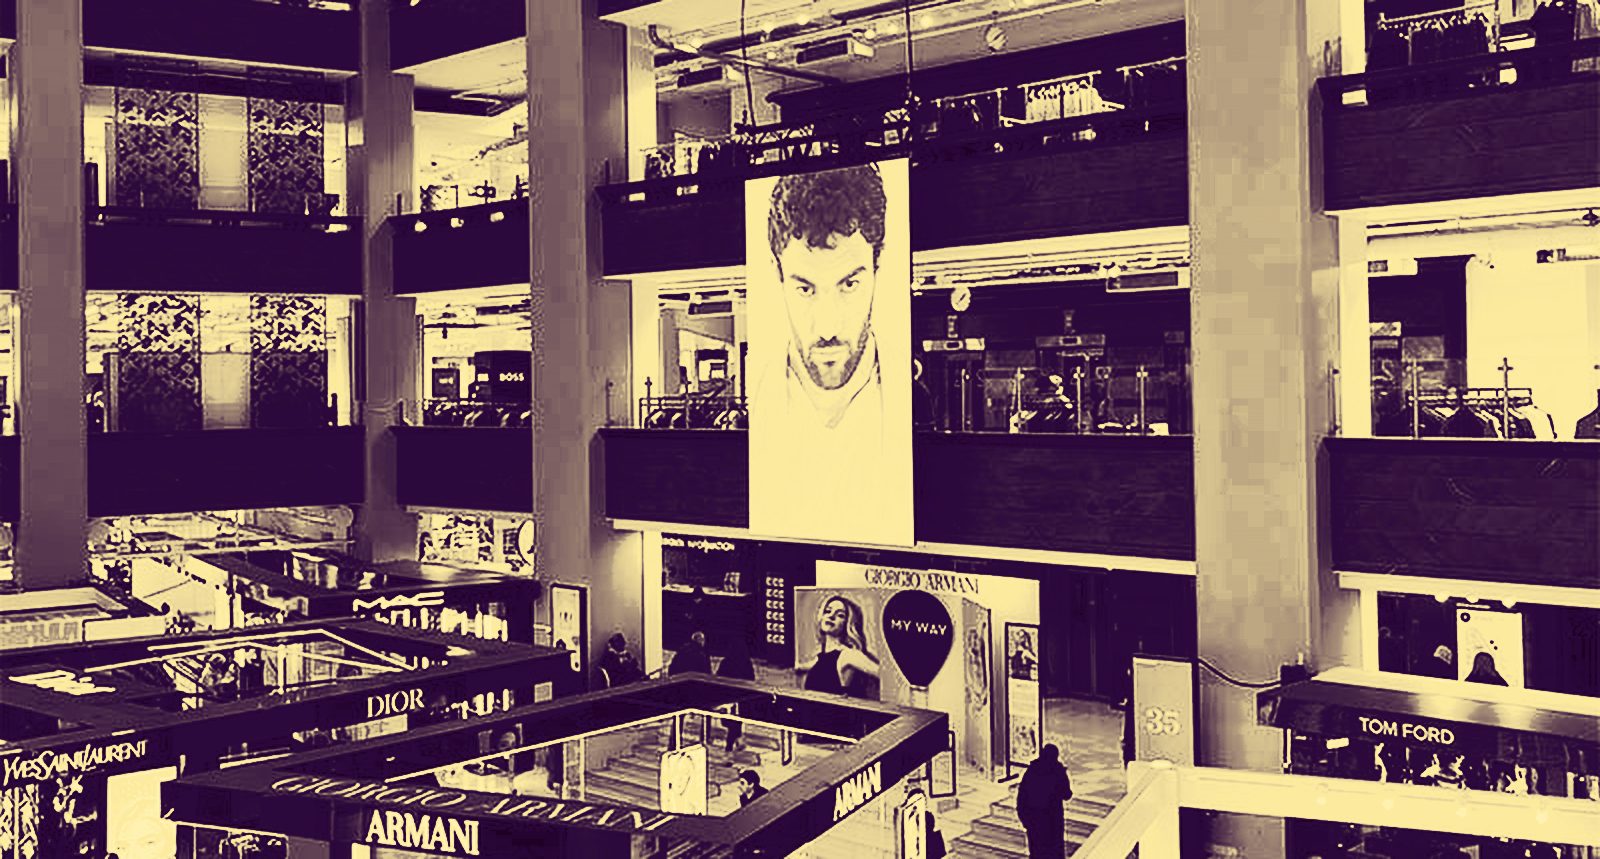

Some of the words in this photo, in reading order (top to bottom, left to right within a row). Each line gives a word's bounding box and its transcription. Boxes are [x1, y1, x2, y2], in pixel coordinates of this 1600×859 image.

[500, 372, 524, 382] BOSS
[865, 569, 921, 588] GIORGIO
[926, 572, 979, 594] ARMANI
[891, 619, 911, 631] MY
[916, 622, 947, 635] WAY
[367, 688, 425, 718] DIOR
[1145, 706, 1181, 736] 35
[1359, 716, 1398, 737] TOM
[1402, 723, 1455, 745] FORD
[271, 776, 467, 808] GIORGIO
[483, 797, 679, 831] ARMANI
[833, 761, 882, 821] ARMANI
[365, 809, 480, 856] ARMANI
